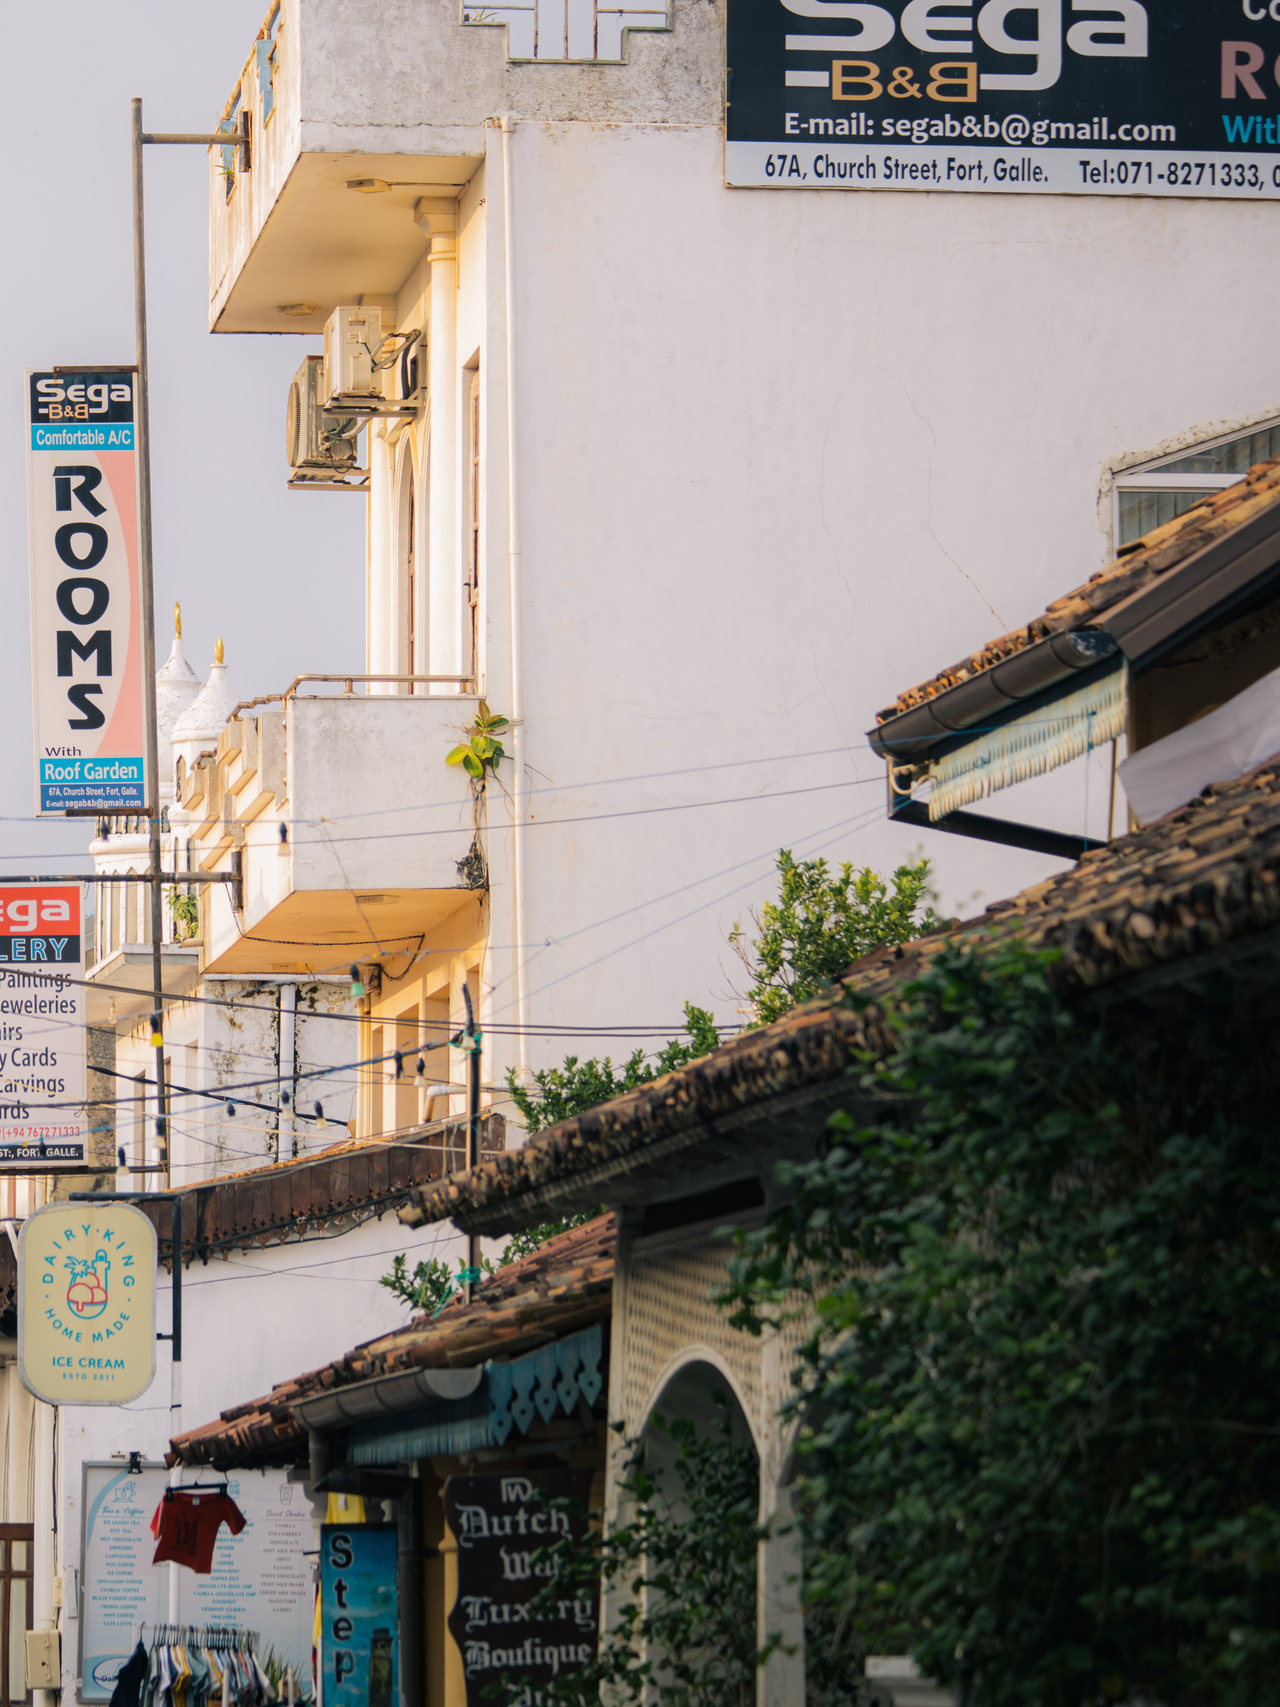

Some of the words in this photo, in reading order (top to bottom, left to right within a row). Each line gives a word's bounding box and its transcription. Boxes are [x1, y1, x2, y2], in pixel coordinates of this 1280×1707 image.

[780, 0, 1148, 91] Sega
[832, 60, 977, 103] B&B
[785, 112, 874, 136] E-mail:
[881, 113, 1176, 145] segab&b@gmail.com
[1222, 114, 1280, 144] Wit
[765, 154, 808, 180] 67A,
[813, 154, 876, 179] Church
[883, 156, 941, 183] Street,
[946, 157, 988, 184] Fort,
[993, 157, 1048, 183] Galle.
[36, 378, 131, 414] Sega
[48, 404, 88, 419] B&B
[36, 429, 104, 446] Comfortable
[108, 430, 131, 444] A/C
[52, 465, 112, 730] ROOMS
[45, 746, 82, 756] With
[45, 762, 80, 780] Roof
[84, 762, 138, 780] Garden
[48, 788, 62, 796] 67A,
[63, 787, 84, 796] Church
[86, 787, 105, 796] Street,
[106, 787, 120, 796] Fort,
[121, 787, 138, 795] Galle.
[66, 799, 141, 808] segab&b@gmail.com
[12, 1047, 57, 1067] Cards
[27, 1127, 50, 1137] 7672
[52, 1126, 80, 1137] 71333
[46, 1148, 78, 1157] GALLE.
[42, 1224, 91, 1284] DAIRY
[103, 1228, 135, 1287] KING
[45, 1308, 82, 1342] HOME
[92, 1312, 130, 1342] MADE
[52, 1356, 72, 1367] ICE
[78, 1358, 124, 1369] CREAM
[454, 1502, 573, 1548] Dutch
[463, 1637, 593, 1680] Boutique
